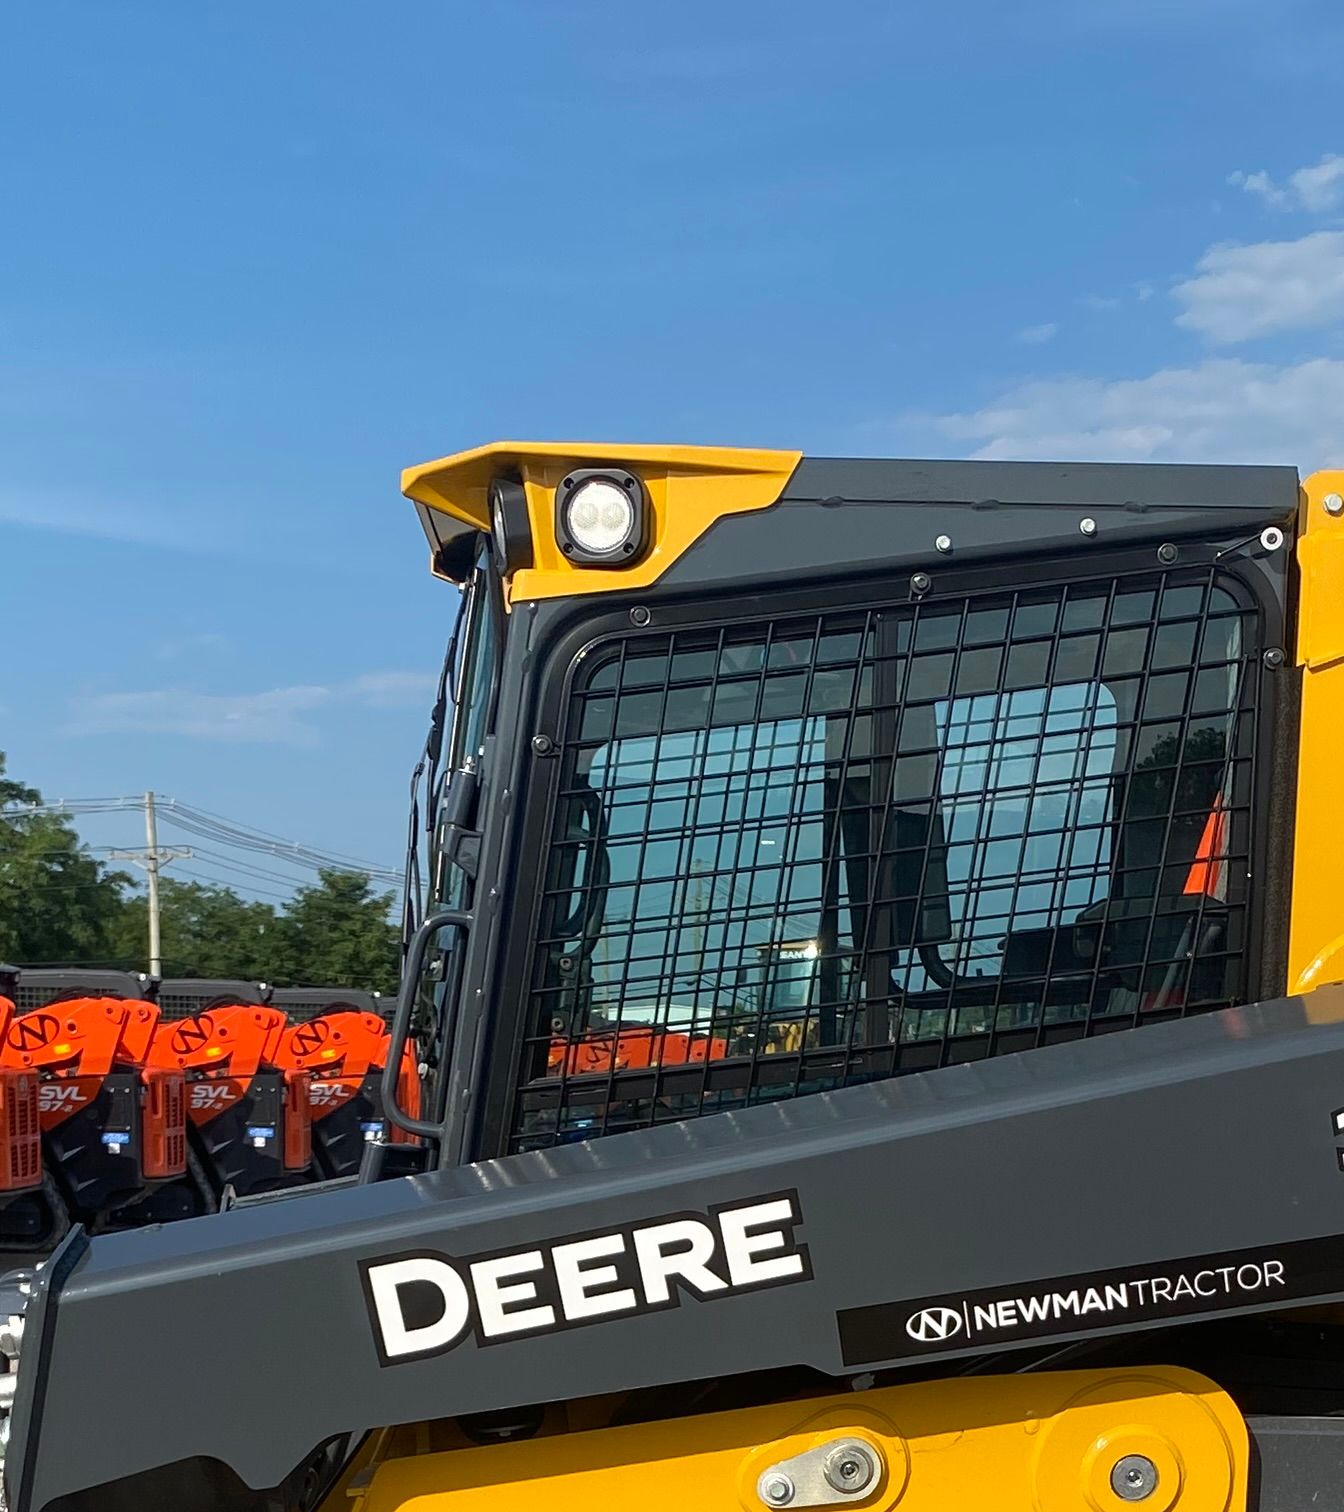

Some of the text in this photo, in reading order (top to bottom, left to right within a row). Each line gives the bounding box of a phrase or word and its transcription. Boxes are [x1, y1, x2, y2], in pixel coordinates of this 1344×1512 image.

[39, 1085, 87, 1101] SVL
[190, 1084, 236, 1099] SVL
[309, 1083, 350, 1097] SVL
[368, 1198, 803, 1358] DEERE
